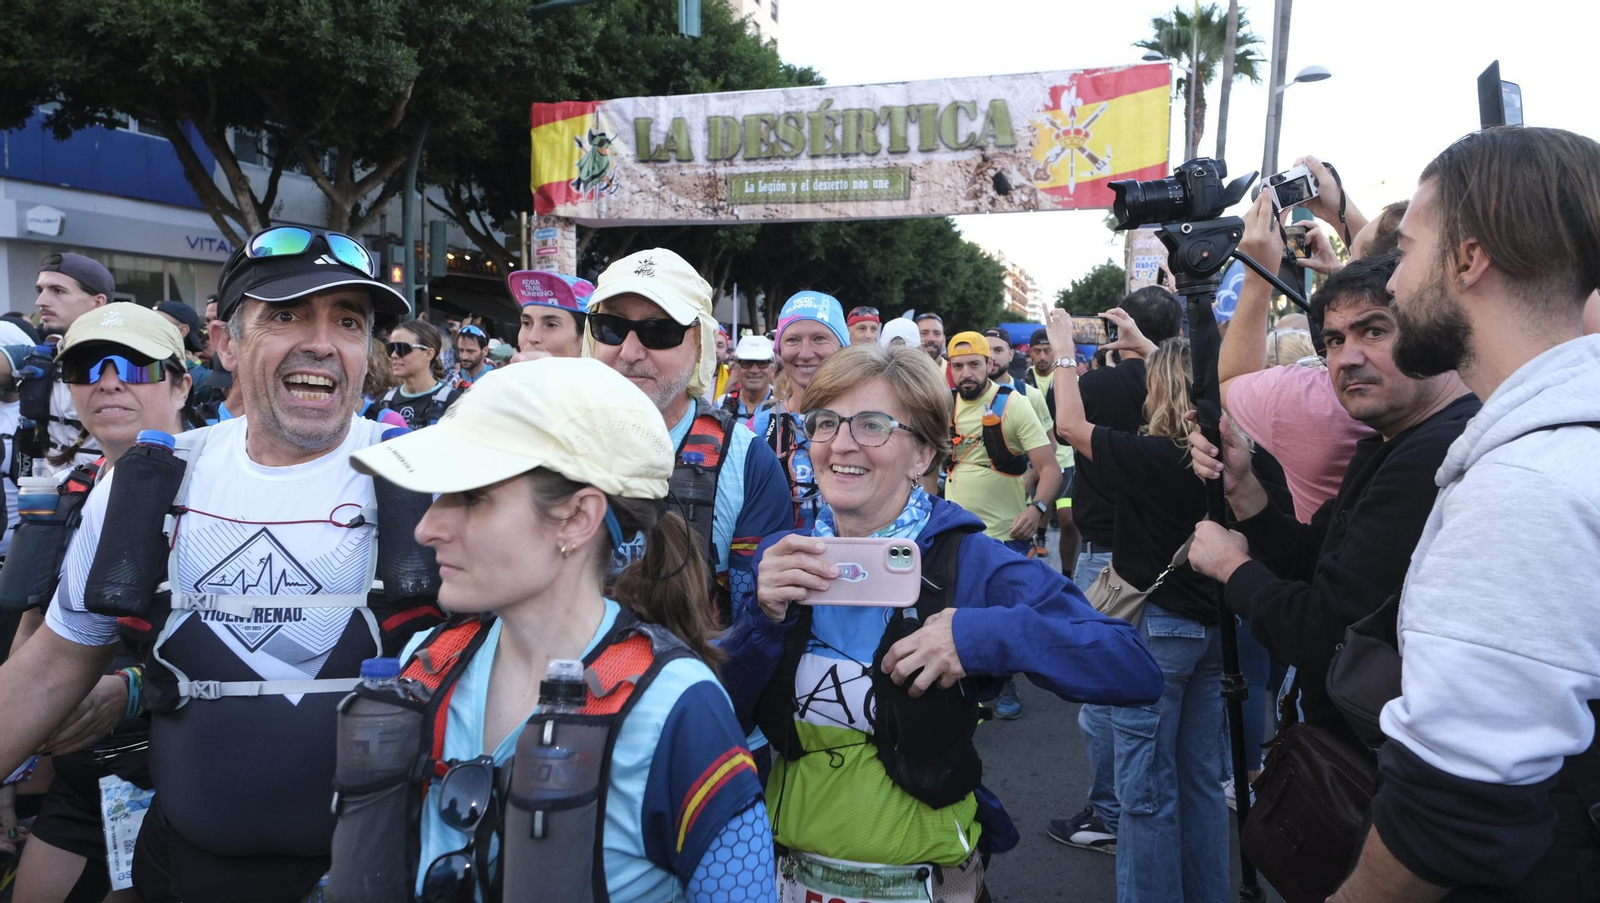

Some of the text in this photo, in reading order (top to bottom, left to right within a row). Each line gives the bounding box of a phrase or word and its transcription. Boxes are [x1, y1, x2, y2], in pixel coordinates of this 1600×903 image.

[634, 98, 1017, 163] LA DESÉRTICA
[744, 178, 889, 194] La Legión y el desierto nos une
